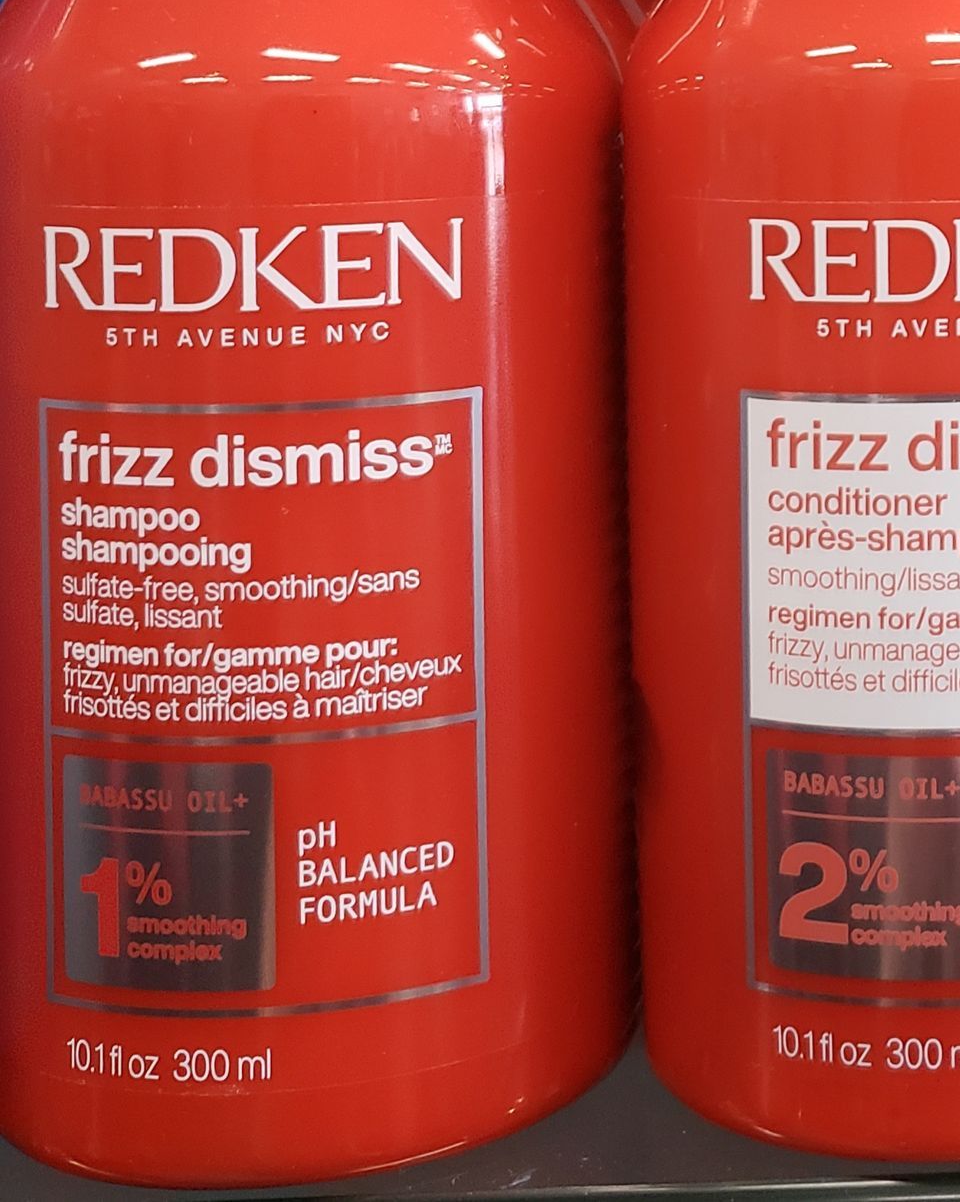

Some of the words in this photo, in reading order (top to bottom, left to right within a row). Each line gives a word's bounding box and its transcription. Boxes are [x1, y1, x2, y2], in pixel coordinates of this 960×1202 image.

[43, 218, 464, 313] REDKEN
[106, 327, 159, 348] 5TH
[177, 325, 307, 347] AVENUE
[326, 321, 391, 344] NYC
[816, 318, 873, 339] 5TH
[58, 430, 175, 486] frizz
[190, 429, 435, 488] dismiss
[766, 417, 889, 472] frizz
[60, 497, 201, 537] shampoo
[768, 486, 948, 517] conditioner
[61, 532, 252, 573] shampooing
[61, 571, 199, 605] sulfate-free,
[204, 568, 421, 604] smoothing/sans
[62, 601, 140, 632] sulfate,
[144, 602, 223, 630] lissant
[768, 603, 871, 634] regimen
[62, 640, 159, 674] regimen
[164, 640, 318, 674] for/gamme
[325, 637, 399, 667] pour:
[768, 630, 830, 664] frizzy,
[62, 664, 121, 701] frizzy,
[123, 666, 300, 703] unmanageable
[305, 652, 463, 692] hair/cheveux
[768, 660, 857, 692] frisottés
[863, 666, 886, 693] et
[63, 691, 151, 721] frisottés
[155, 696, 180, 722] et
[185, 691, 288, 723] difficiles
[293, 690, 311, 717] à
[315, 683, 428, 716] maîtriser
[80, 783, 172, 813] BABASSU
[187, 790, 249, 814] OIL+
[784, 770, 885, 799] BABASSU
[900, 777, 960, 800] OIL+
[298, 821, 336, 856] pH
[299, 841, 455, 887] BALANCED
[300, 880, 437, 925] FORMULA
[127, 914, 247, 940] smoothing
[850, 926, 948, 952] complex
[127, 940, 222, 966] complex
[67, 1038, 106, 1075] 10.1
[110, 1043, 122, 1077] fl
[128, 1053, 160, 1082] oz
[172, 1048, 230, 1083] 300
[237, 1048, 272, 1081] ml
[773, 1025, 815, 1061] 10.1
[819, 1031, 834, 1064] fl
[840, 1041, 872, 1069] oz
[885, 1037, 943, 1070] 300
